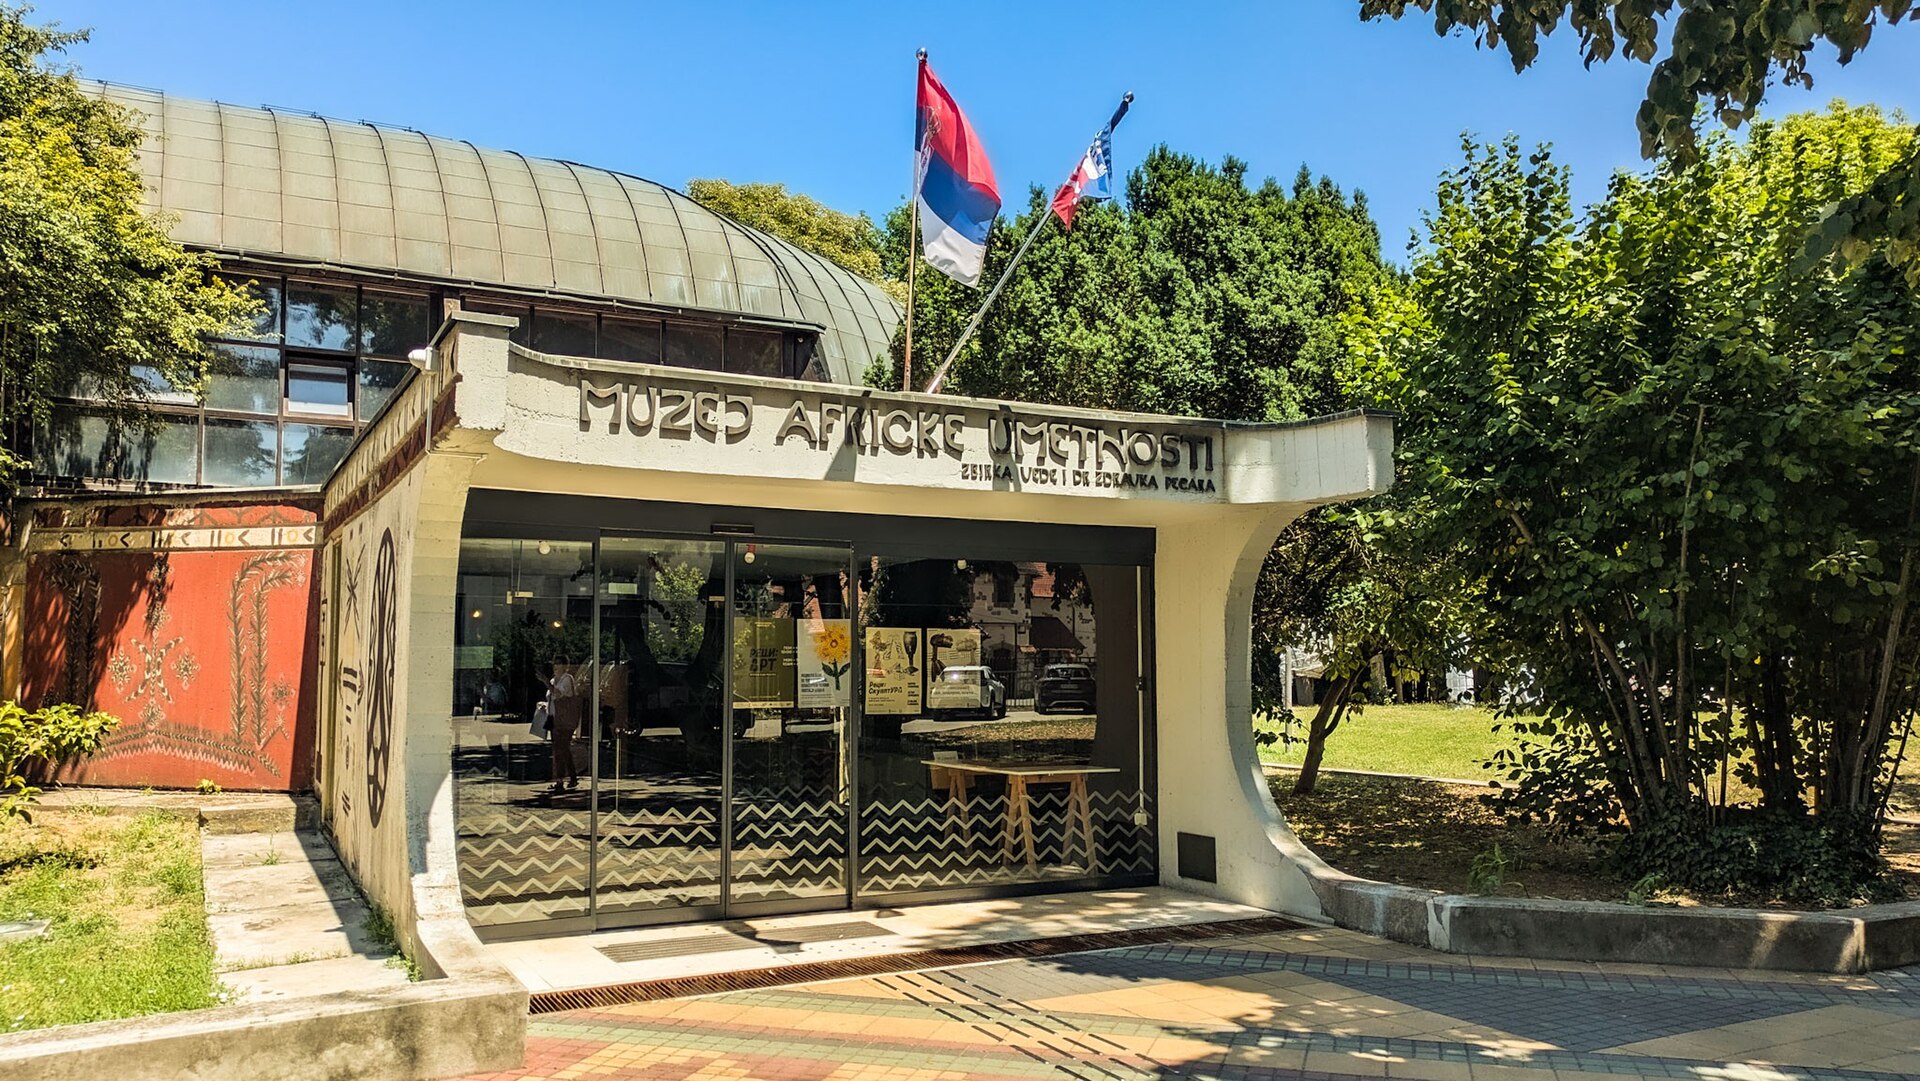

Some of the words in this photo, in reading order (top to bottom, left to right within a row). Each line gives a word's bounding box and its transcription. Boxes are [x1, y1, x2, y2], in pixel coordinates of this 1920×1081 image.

[579, 380, 753, 443] MUZEJ
[988, 416, 1214, 472] UMETNOSTI
[961, 463, 1013, 483] ZBIRKA
[1062, 469, 1067, 487] I
[1072, 470, 1089, 488] DR
[1095, 471, 1159, 490] ZDRAVKA
